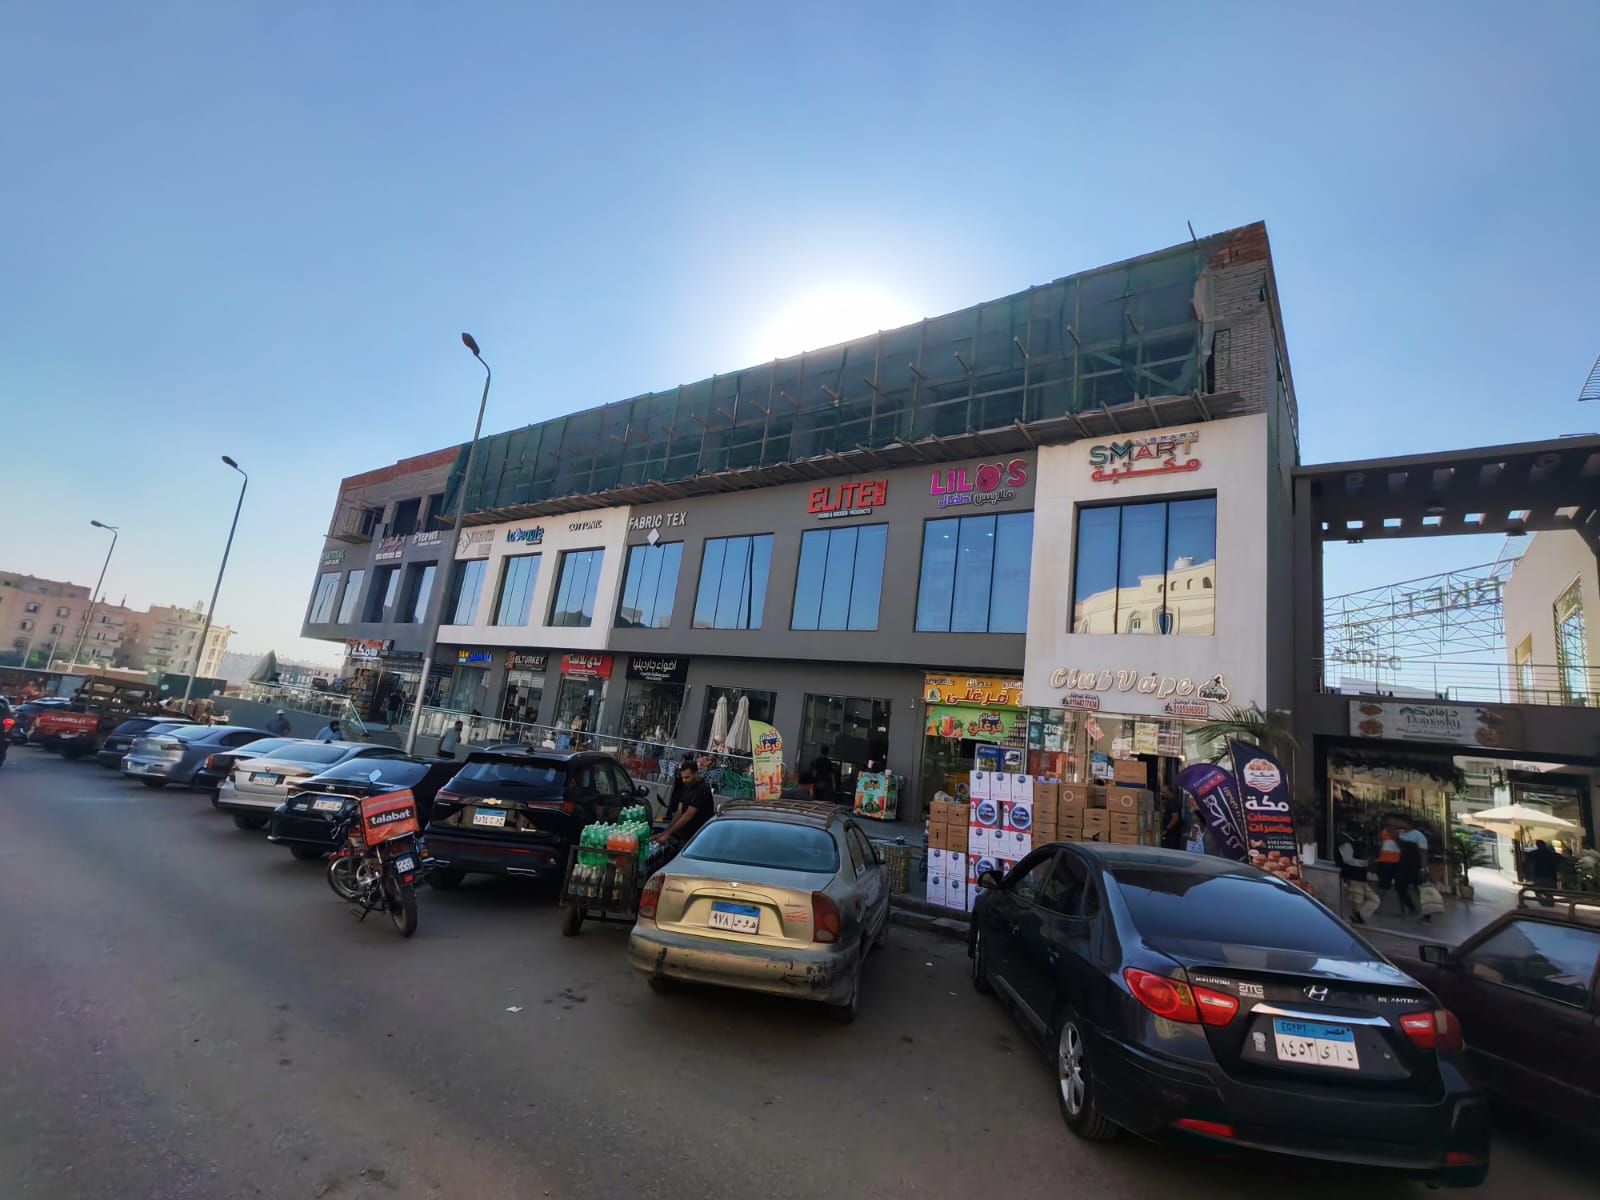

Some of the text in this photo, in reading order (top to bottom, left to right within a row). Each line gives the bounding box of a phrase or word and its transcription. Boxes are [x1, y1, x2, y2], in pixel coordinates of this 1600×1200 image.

[1089, 439, 1199, 465] SMART
[807, 481, 874, 513] ELITE
[628, 511, 688, 531] FABRIC TEX
[1050, 667, 1195, 699] Club Vape
[1245, 794, 1289, 812] مكة
[371, 808, 411, 825] talabat
[1281, 1021, 1307, 1032] EGYPT
[1280, 1040, 1313, 1058] ٨٤٥٣
